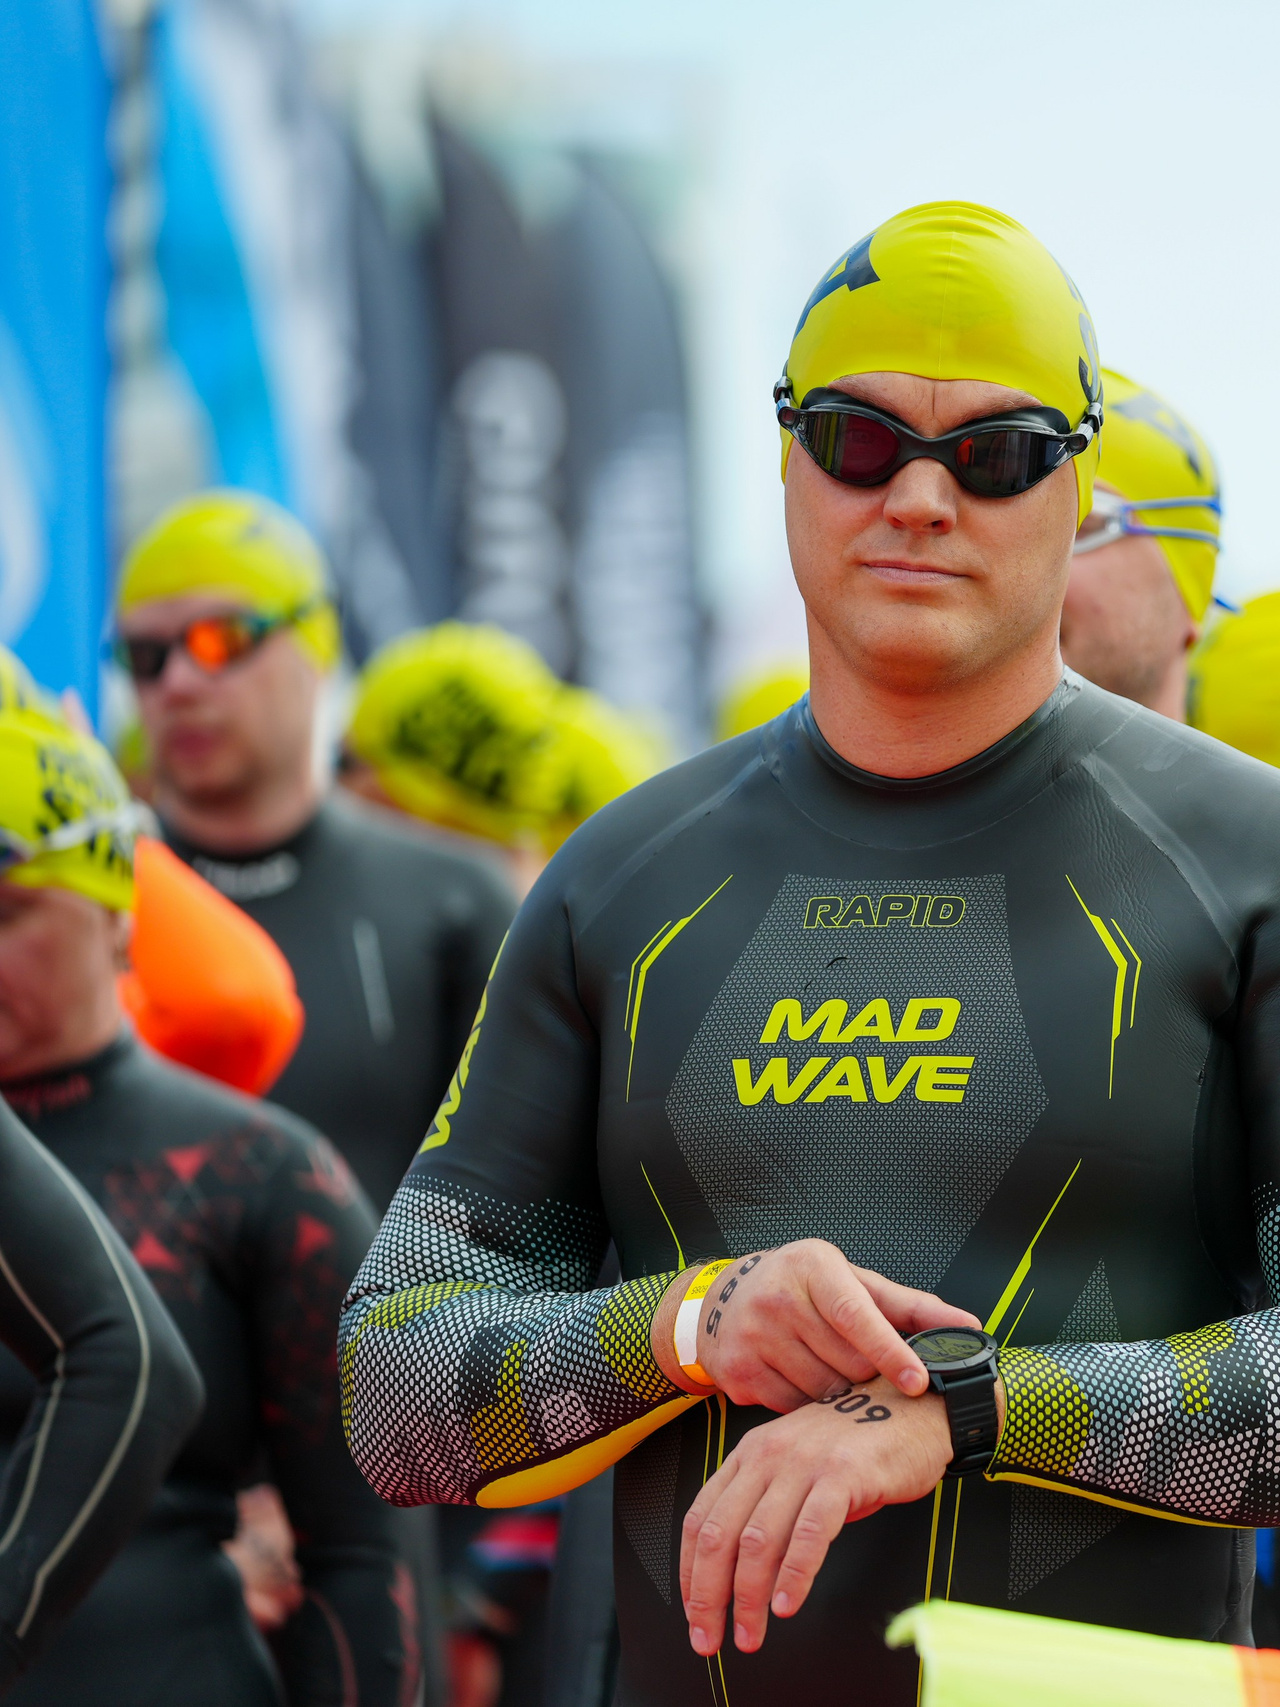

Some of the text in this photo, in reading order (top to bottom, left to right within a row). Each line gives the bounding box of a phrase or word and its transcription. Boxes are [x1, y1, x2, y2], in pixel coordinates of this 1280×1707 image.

[803, 894, 967, 929] RAPID
[759, 997, 961, 1044] MAD
[731, 1055, 976, 1107] WAVE
[706, 1249, 775, 1338] 085
